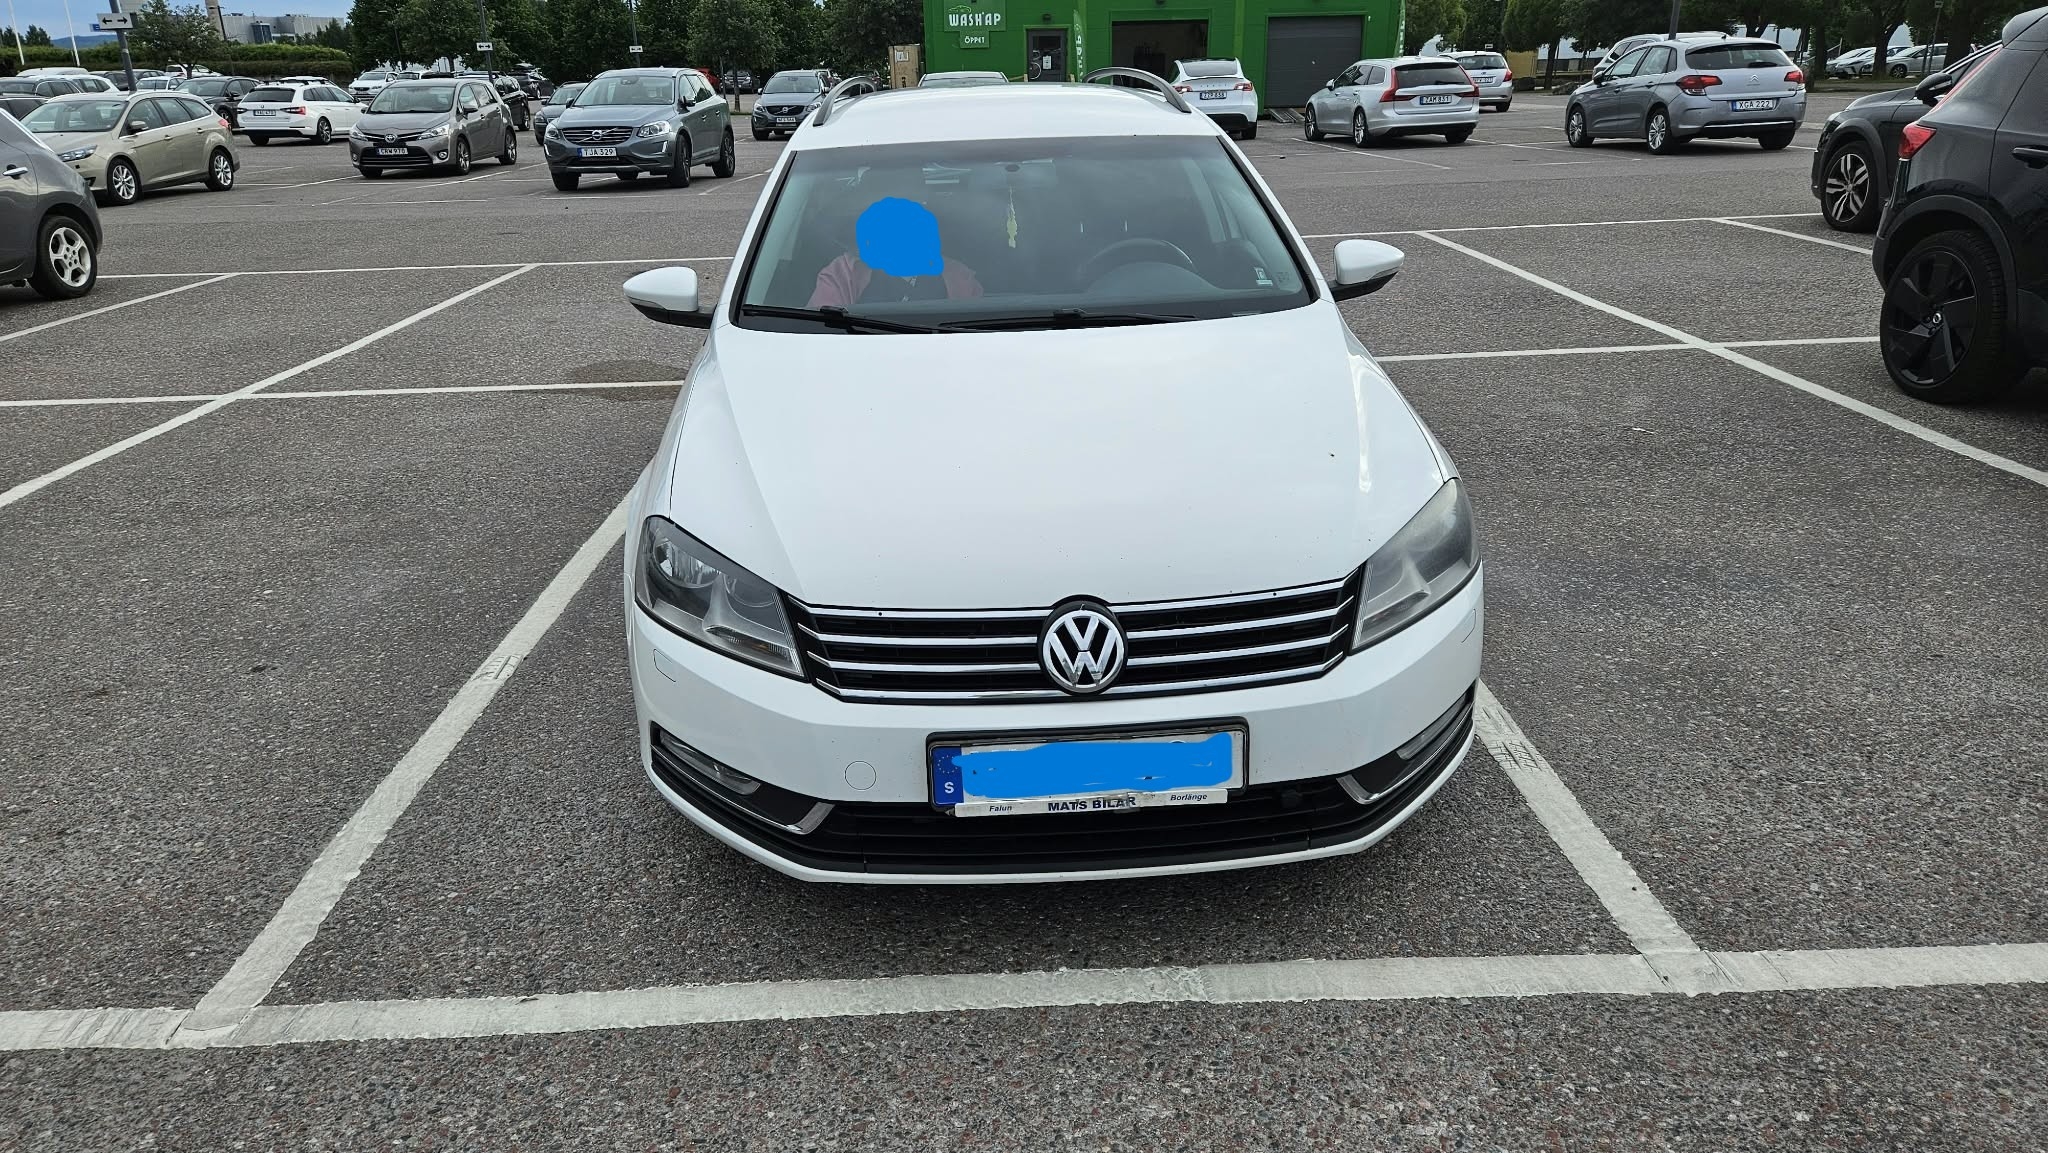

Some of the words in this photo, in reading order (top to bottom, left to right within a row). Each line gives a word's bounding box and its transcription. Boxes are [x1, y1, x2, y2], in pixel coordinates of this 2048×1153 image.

[948, 12, 1001, 27] WASH'AP
[964, 35, 985, 44] ÖPPET
[1739, 101, 1754, 109] XGA
[1756, 100, 1770, 108] 222
[584, 148, 599, 156] TJA
[600, 148, 614, 156] 329
[944, 781, 955, 794] S
[989, 804, 1012, 813] Falun
[1048, 800, 1088, 812] MATS
[1170, 793, 1208, 803] Borlänge
